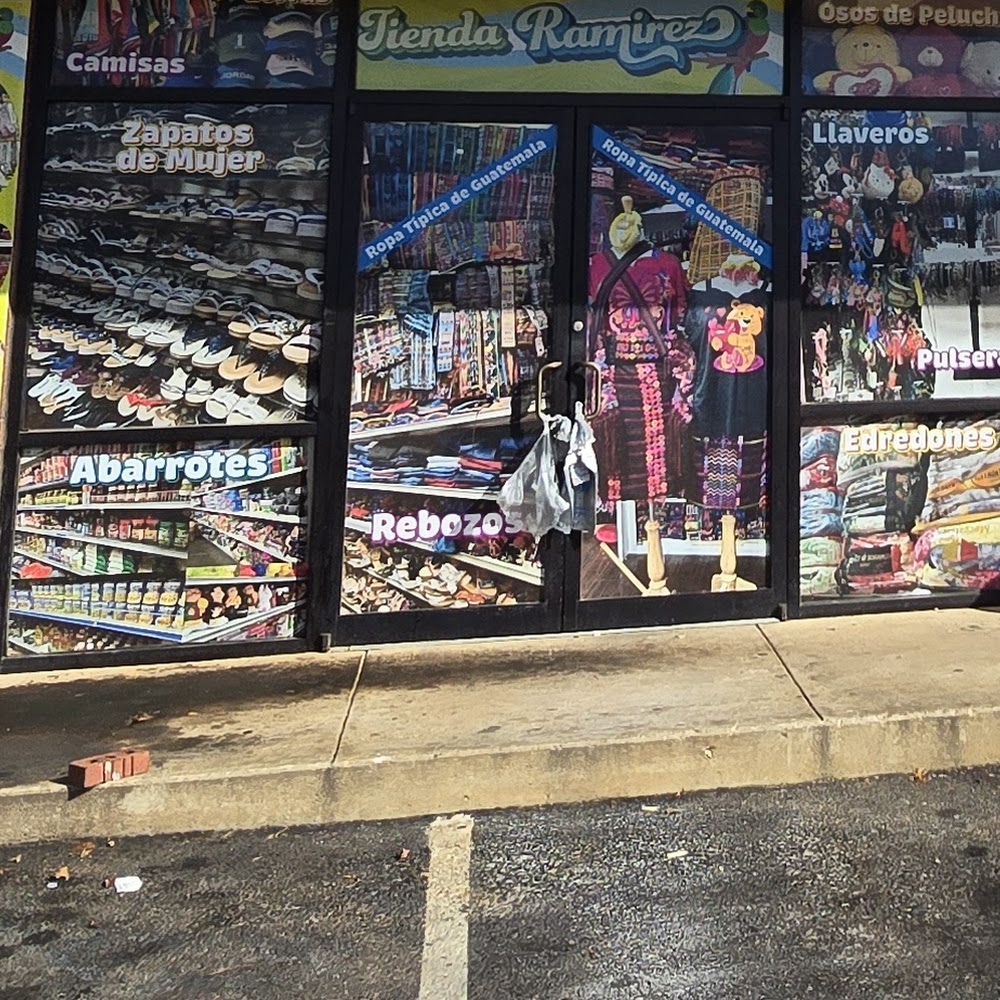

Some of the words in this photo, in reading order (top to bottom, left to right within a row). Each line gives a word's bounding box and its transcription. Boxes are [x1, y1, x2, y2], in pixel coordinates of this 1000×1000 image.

[883, 3, 914, 25] de
[358, 6, 508, 56] Tienda
[514, 4, 742, 73] Ramirez
[66, 53, 185, 73] Camisas
[121, 120, 254, 147] Zapatos
[813, 123, 929, 144] Llaveros
[116, 148, 157, 173] de
[165, 149, 264, 177] Mujer
[365, 231, 404, 259] Ropa
[403, 202, 450, 233] Típica
[450, 189, 470, 206] de
[471, 140, 546, 192] Guatemala
[602, 138, 635, 167] Ropa
[636, 161, 676, 195] Típica
[677, 191, 695, 208] de
[695, 204, 764, 256] Guatemala
[842, 425, 996, 453] Edredones
[69, 451, 269, 486] Abarrotes
[372, 510, 524, 543] Rebozos
